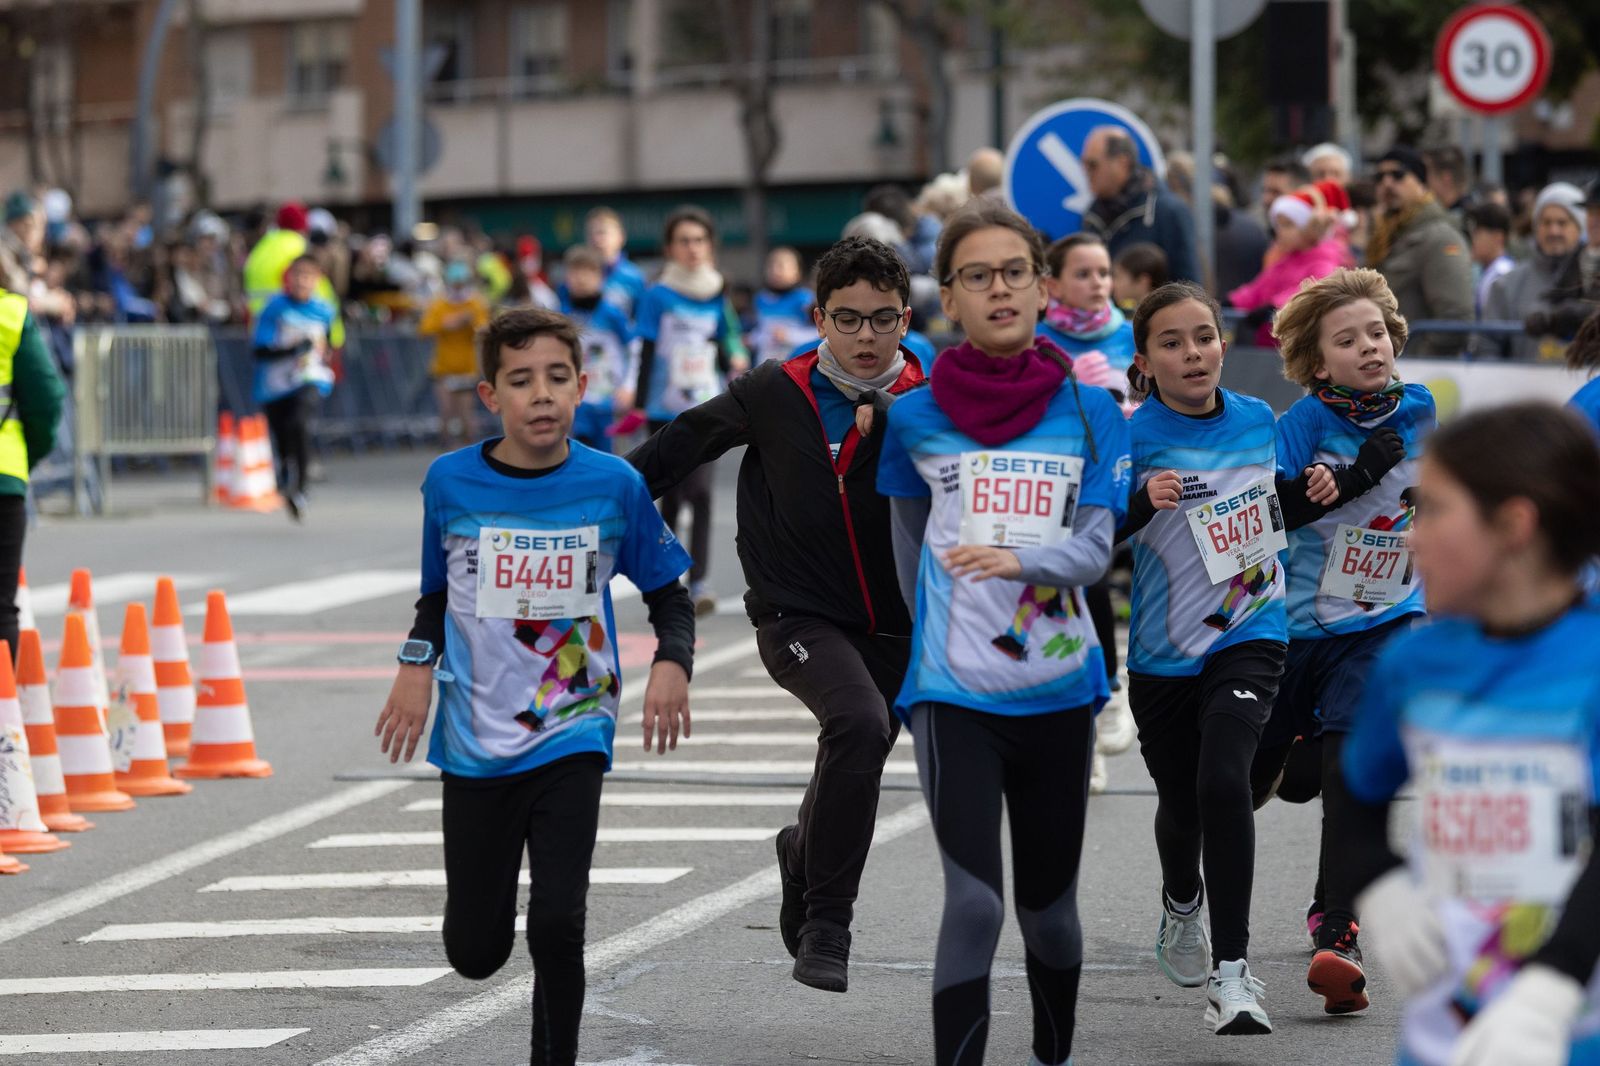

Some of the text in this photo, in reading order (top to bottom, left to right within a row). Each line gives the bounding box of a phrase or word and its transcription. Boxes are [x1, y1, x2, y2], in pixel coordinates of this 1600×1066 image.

[1462, 42, 1522, 79] 30
[992, 458, 1071, 477] SETEL
[1182, 475, 1199, 484] SAN
[972, 478, 1053, 517] 6506
[1179, 489, 1218, 501] LMANTINA
[1182, 482, 1208, 493] VESTRE
[1214, 484, 1267, 516] SETEL
[514, 534, 588, 551] SETEL
[1207, 503, 1264, 554] 6473
[495, 554, 573, 590] 6449
[1342, 546, 1400, 579] 6427
